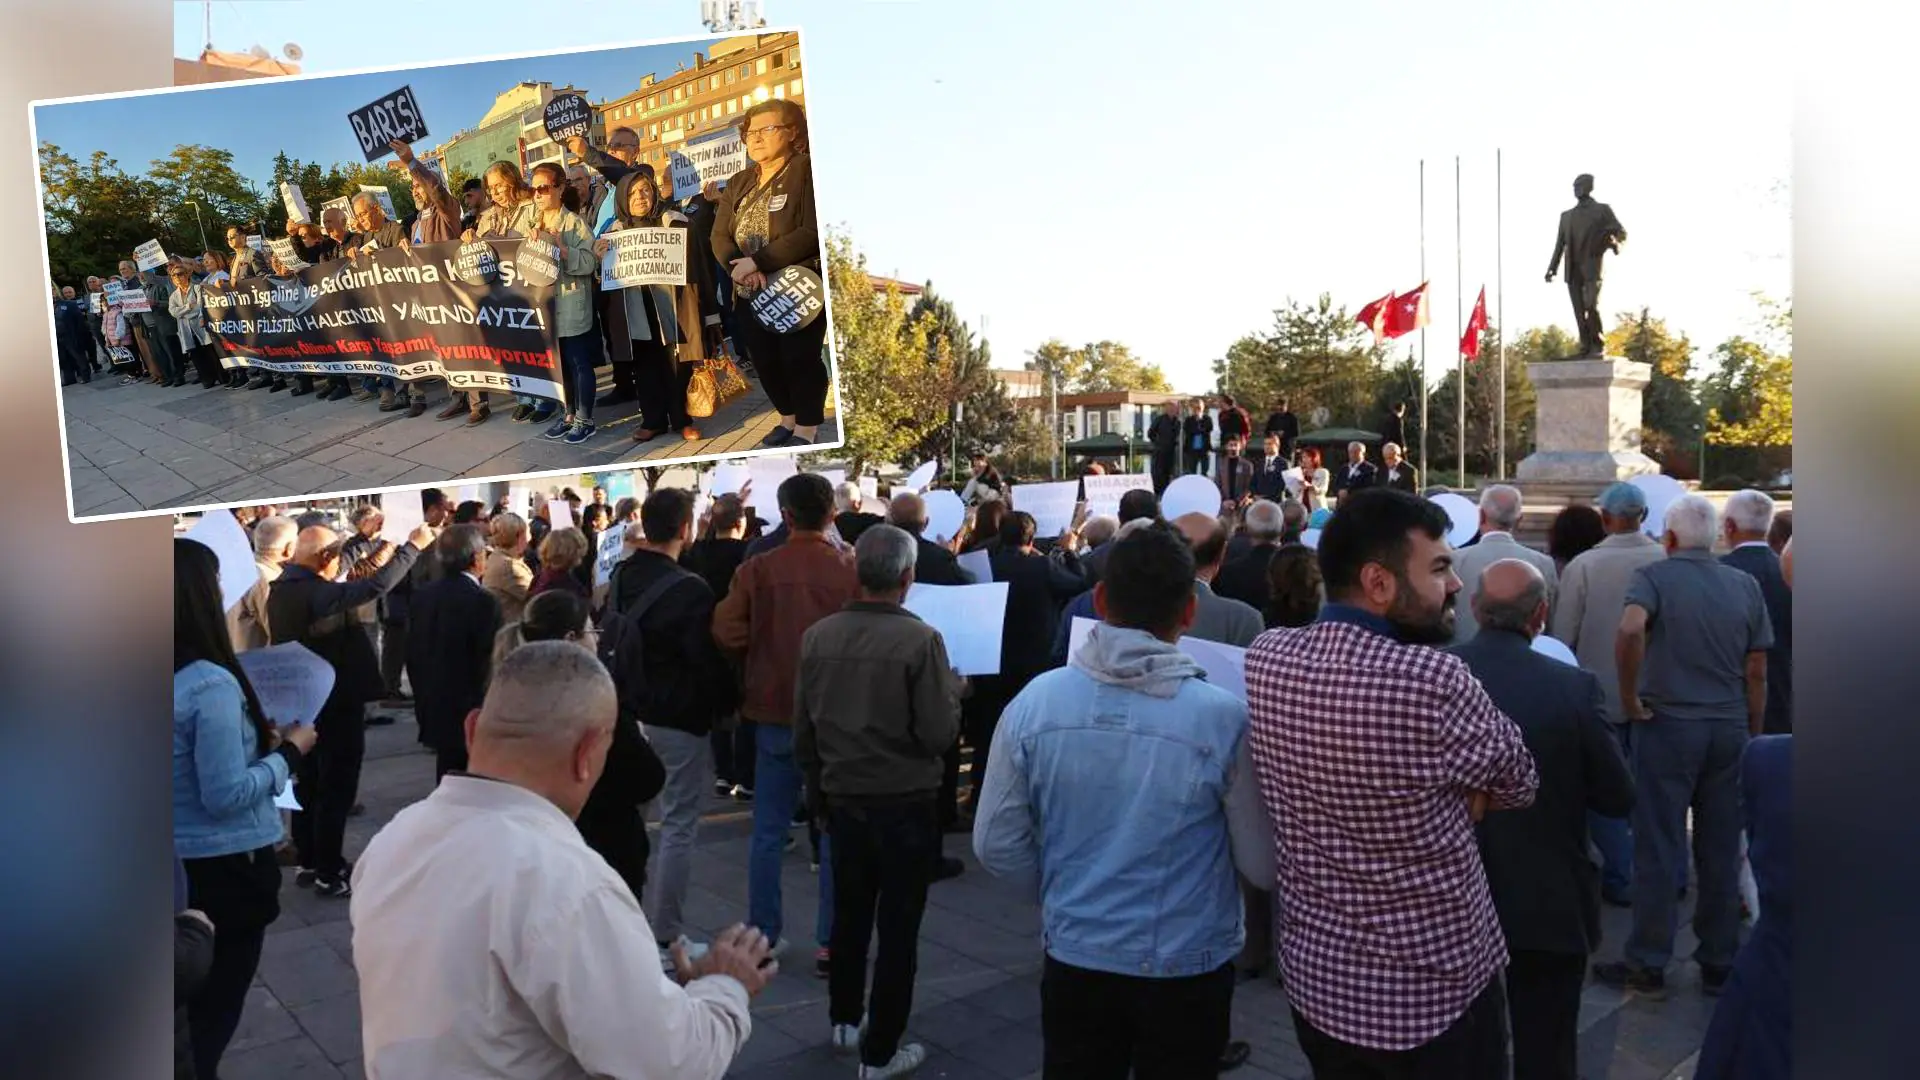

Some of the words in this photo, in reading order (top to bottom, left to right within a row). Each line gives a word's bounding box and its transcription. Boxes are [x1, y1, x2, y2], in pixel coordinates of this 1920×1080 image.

[546, 95, 579, 116] SAVAŞ
[351, 88, 423, 152] BARIŞ!
[546, 110, 589, 130] DEĞİL,
[552, 121, 588, 141] BARIŞ!
[674, 147, 711, 170] FİLİSTİN
[713, 139, 742, 159] HALKI
[702, 158, 742, 180] DEĞİLDİR
[457, 250, 495, 270] HEMEN
[618, 246, 667, 263] YENİLECEK,
[604, 265, 634, 282] HALKLAR
[635, 261, 682, 276] KAZANACAK!
[303, 283, 319, 300] ve
[758, 276, 817, 326] HEMEN
[256, 315, 303, 334] FİLİSTİN
[303, 305, 386, 331] HALKININ
[290, 363, 322, 371] EMEK
[324, 363, 342, 371] VE
[344, 362, 434, 377] DEMOKRASİ
